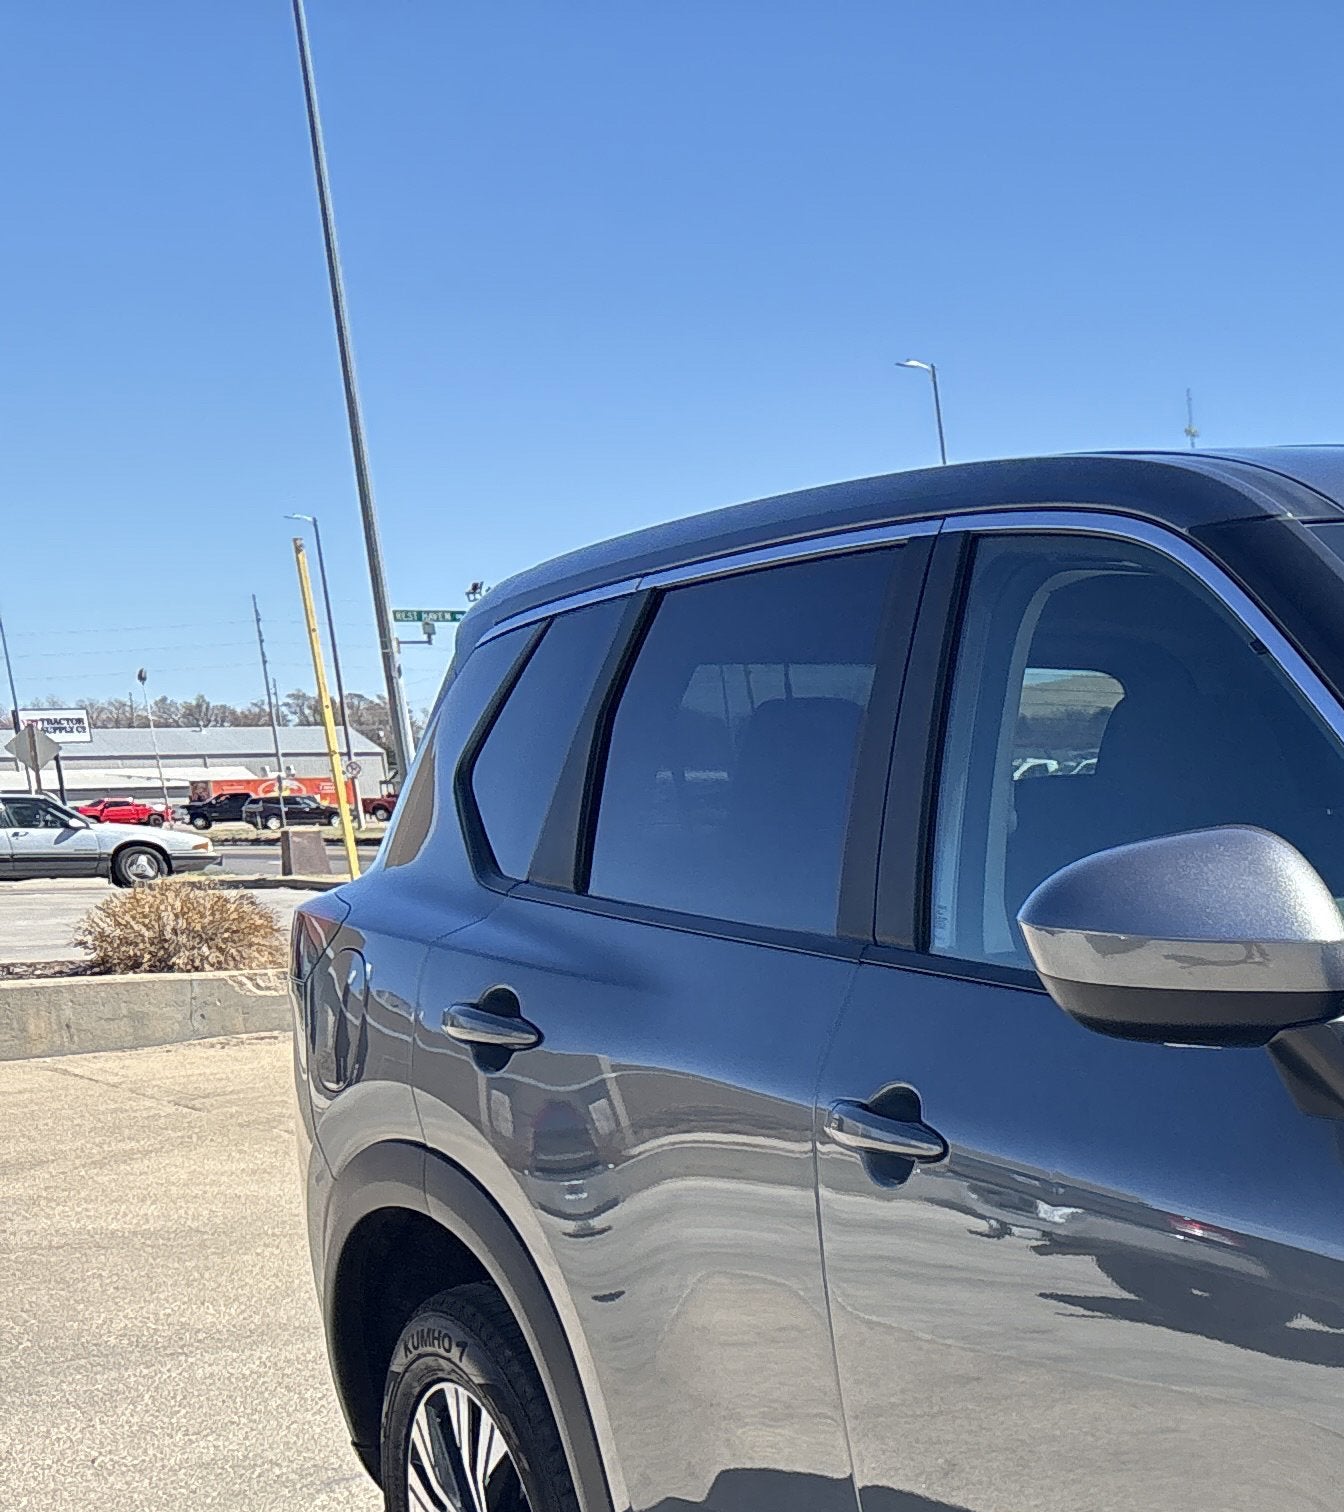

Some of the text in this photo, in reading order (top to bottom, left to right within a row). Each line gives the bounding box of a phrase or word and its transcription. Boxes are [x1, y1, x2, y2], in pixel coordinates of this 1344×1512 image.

[39, 717, 85, 726] TRACTOR
[41, 725, 75, 735] SUPPLY
[403, 1327, 453, 1359] KUMHO
